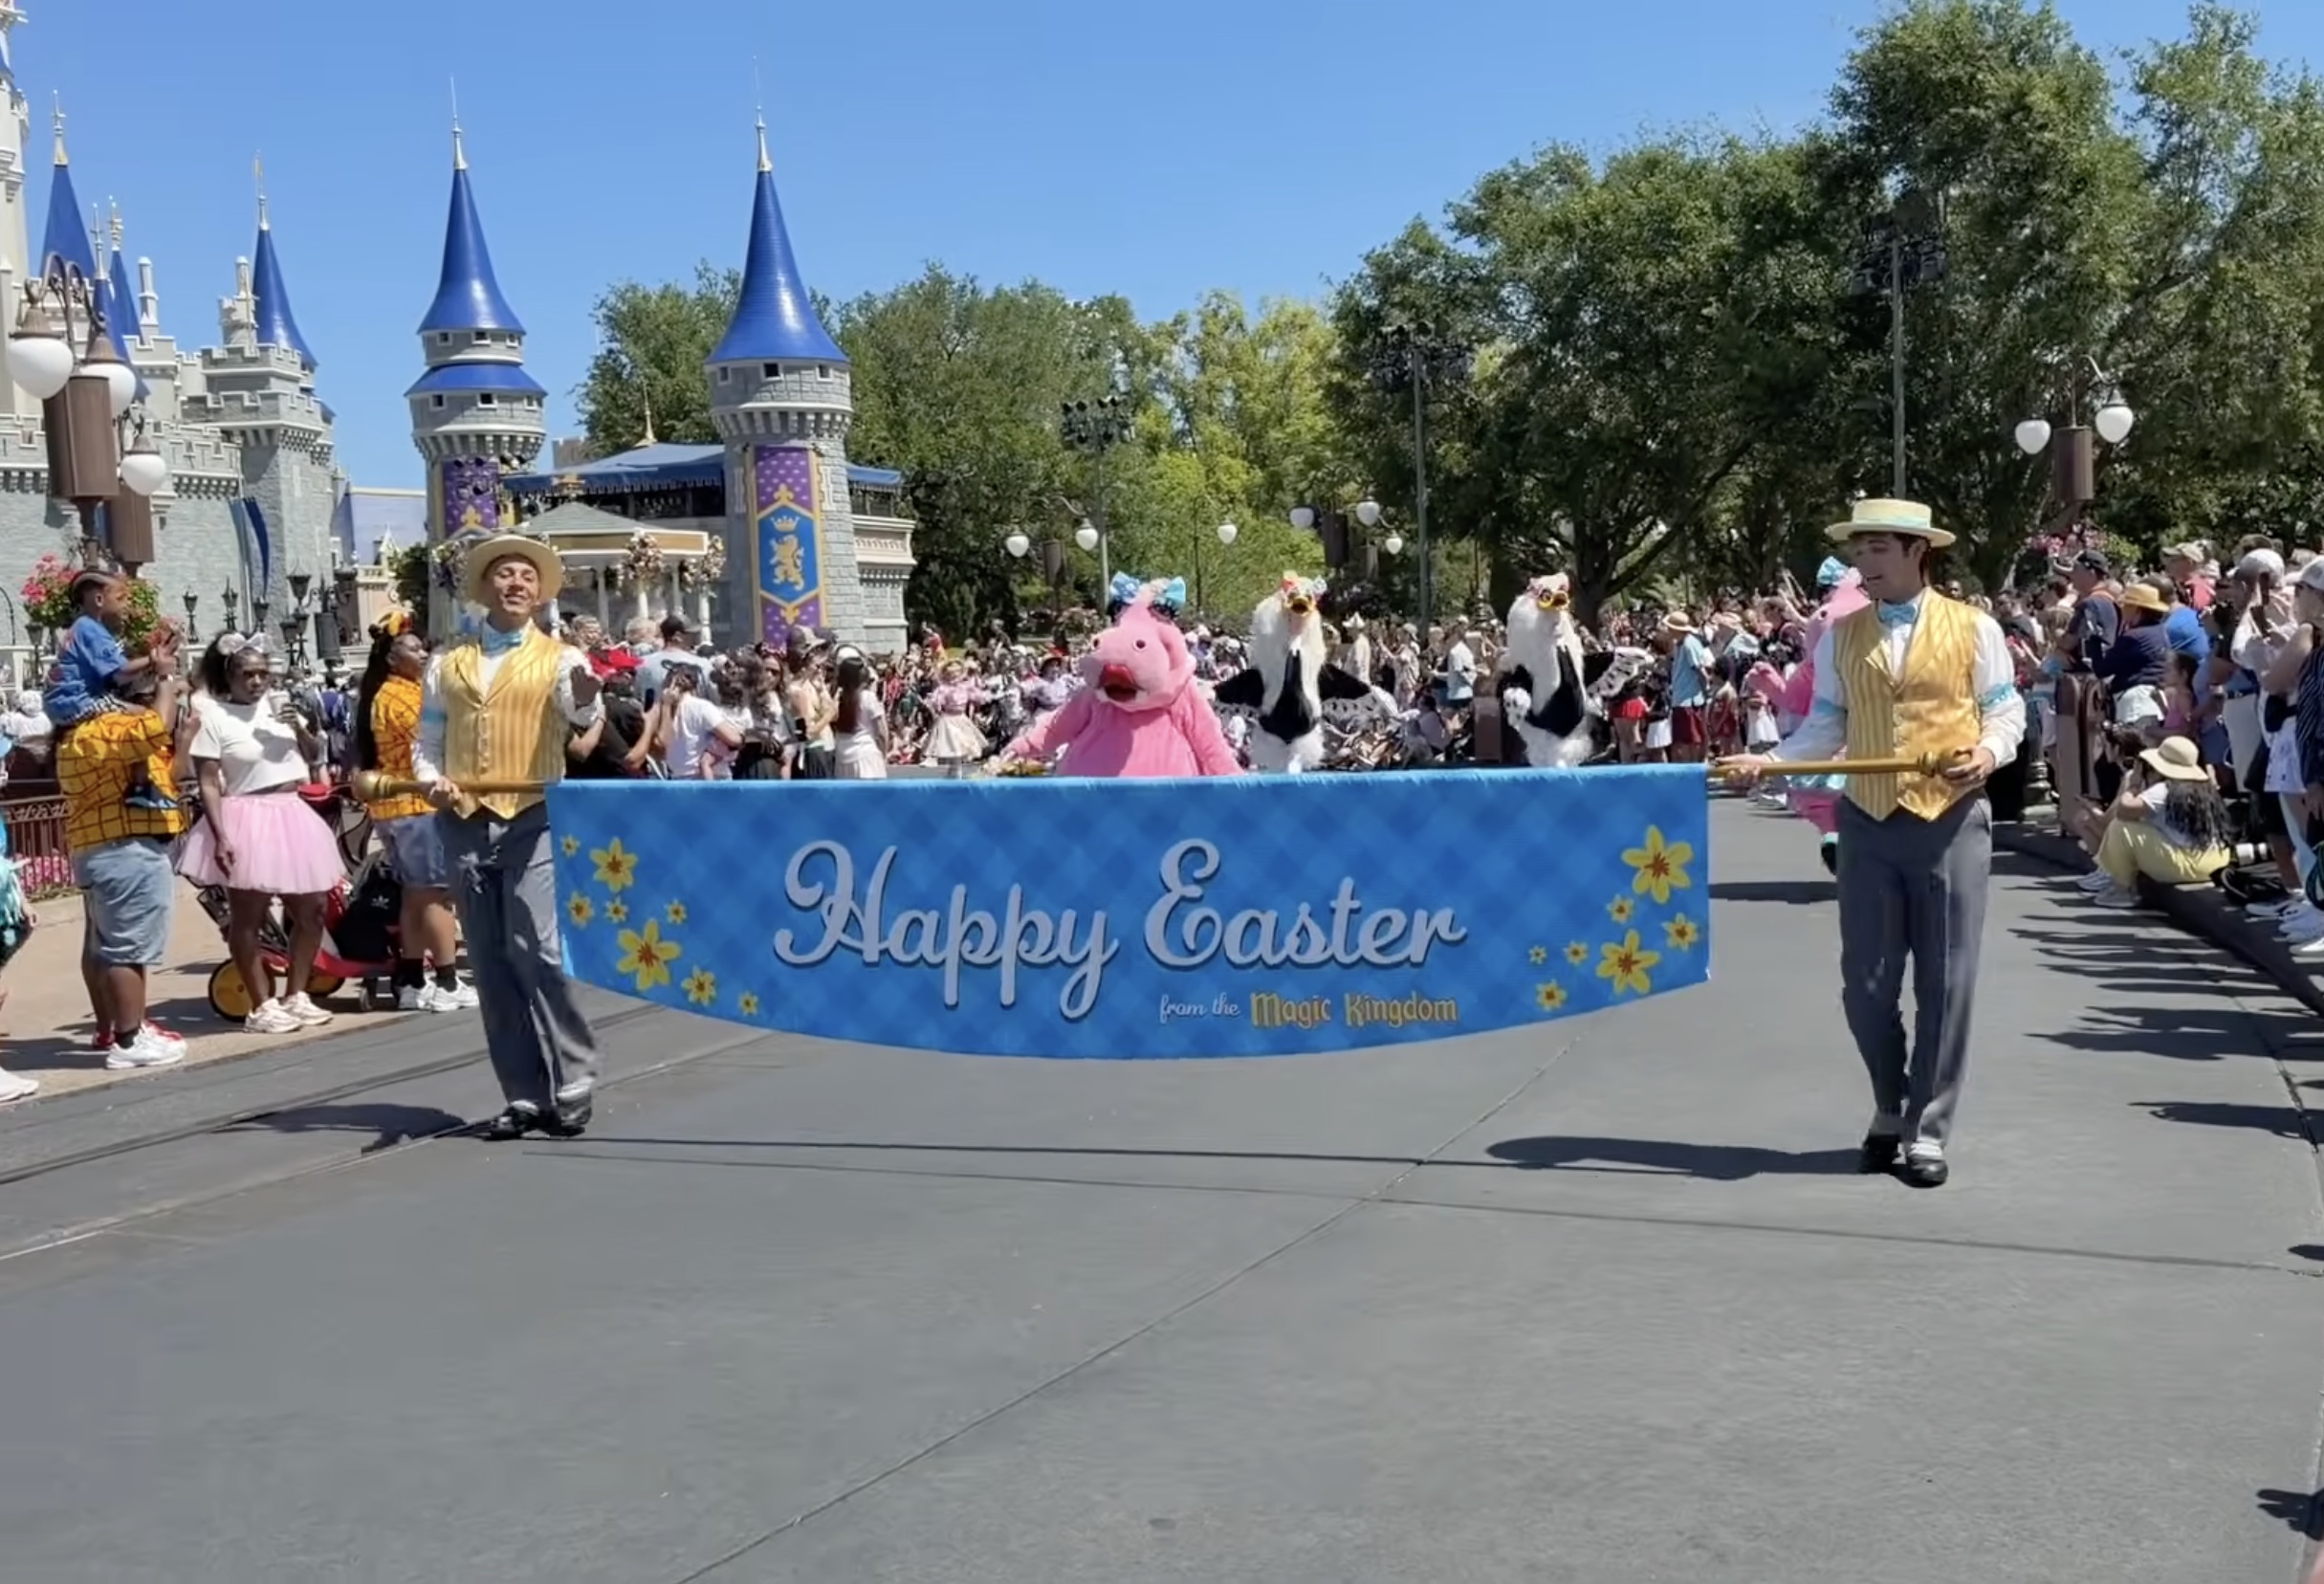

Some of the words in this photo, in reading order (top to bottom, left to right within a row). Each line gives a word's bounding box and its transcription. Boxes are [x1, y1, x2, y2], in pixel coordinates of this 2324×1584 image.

[773, 839, 1120, 1022] Happy
[1143, 838, 1468, 970] Easter
[1159, 993, 1207, 1024] from
[1211, 992, 1241, 1018] the
[1249, 991, 1331, 1030] Magic
[1344, 991, 1458, 1029] Kingdom
